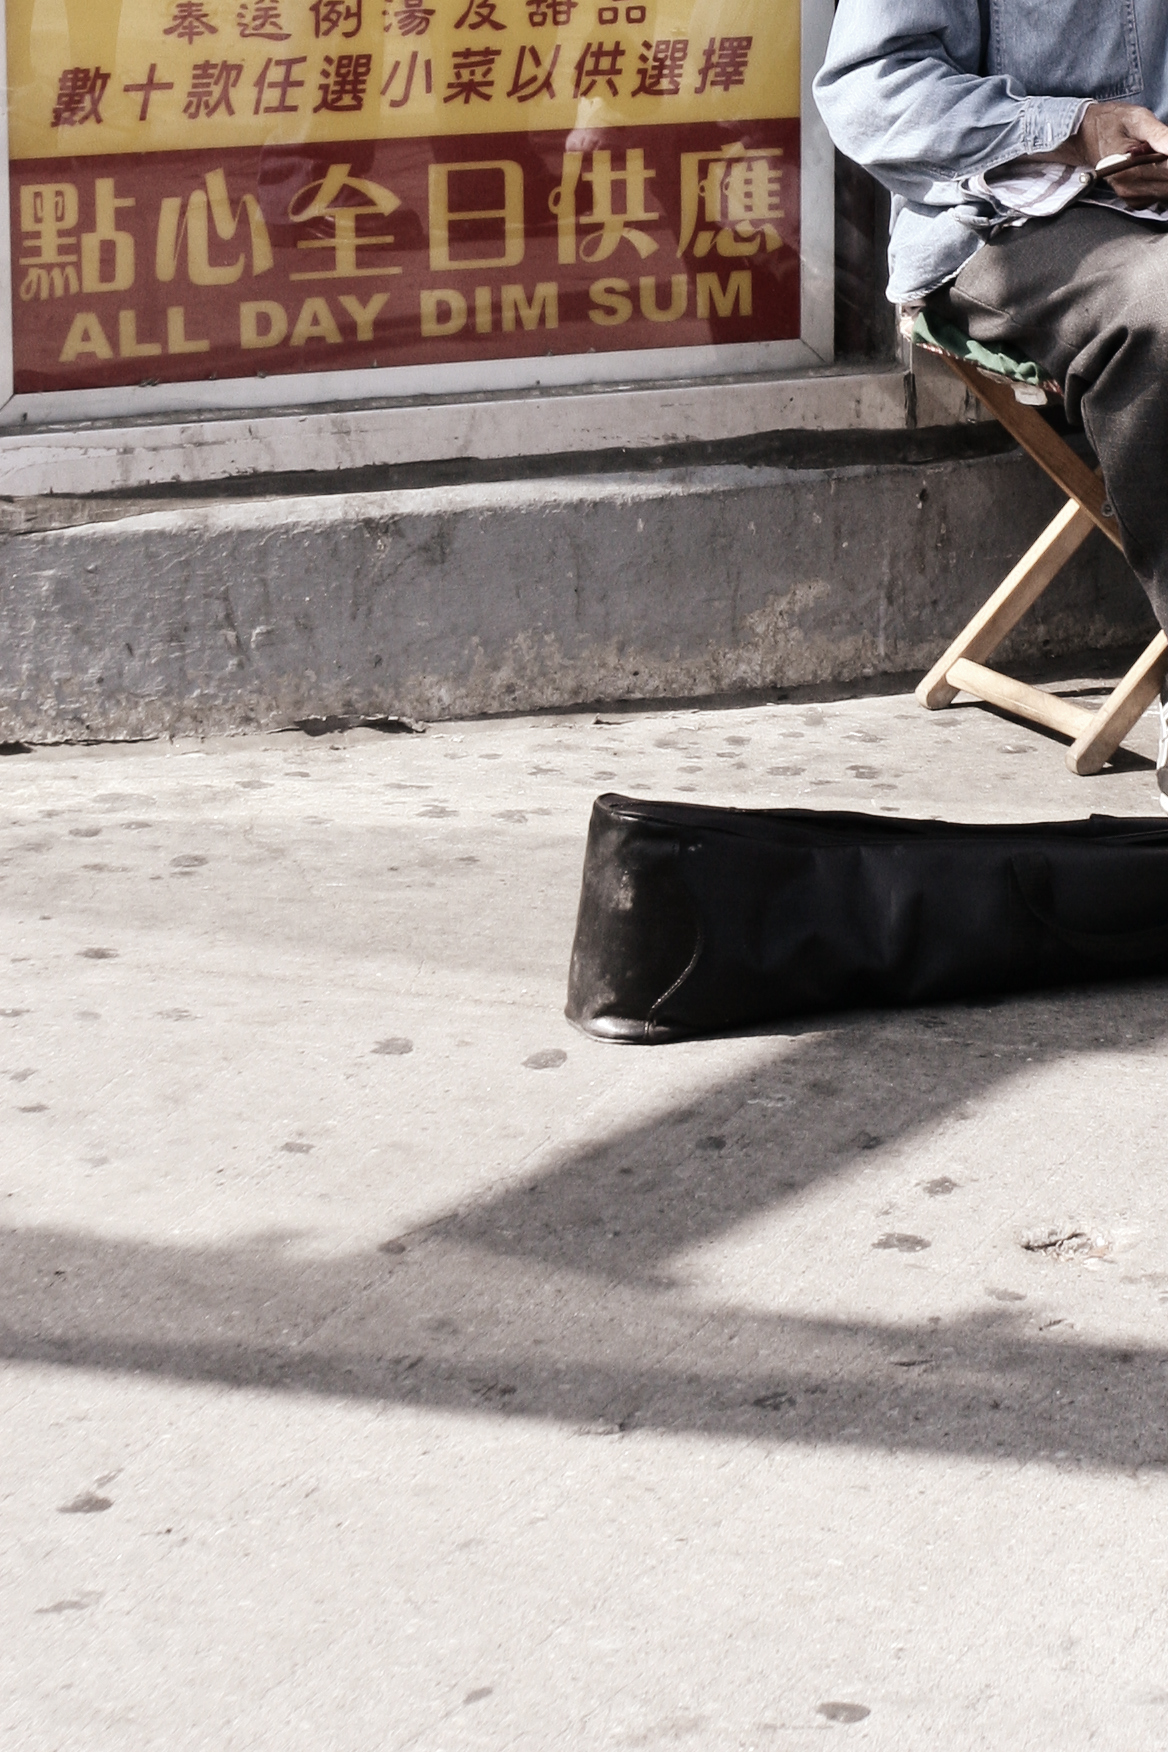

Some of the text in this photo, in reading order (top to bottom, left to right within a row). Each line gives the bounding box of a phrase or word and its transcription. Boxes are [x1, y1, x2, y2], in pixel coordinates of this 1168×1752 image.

[51, 35, 753, 128] 數十款任選小菜以供選擇
[19, 141, 785, 302] 點心全日供應
[58, 270, 753, 363] ALL DAY DIM SUM
